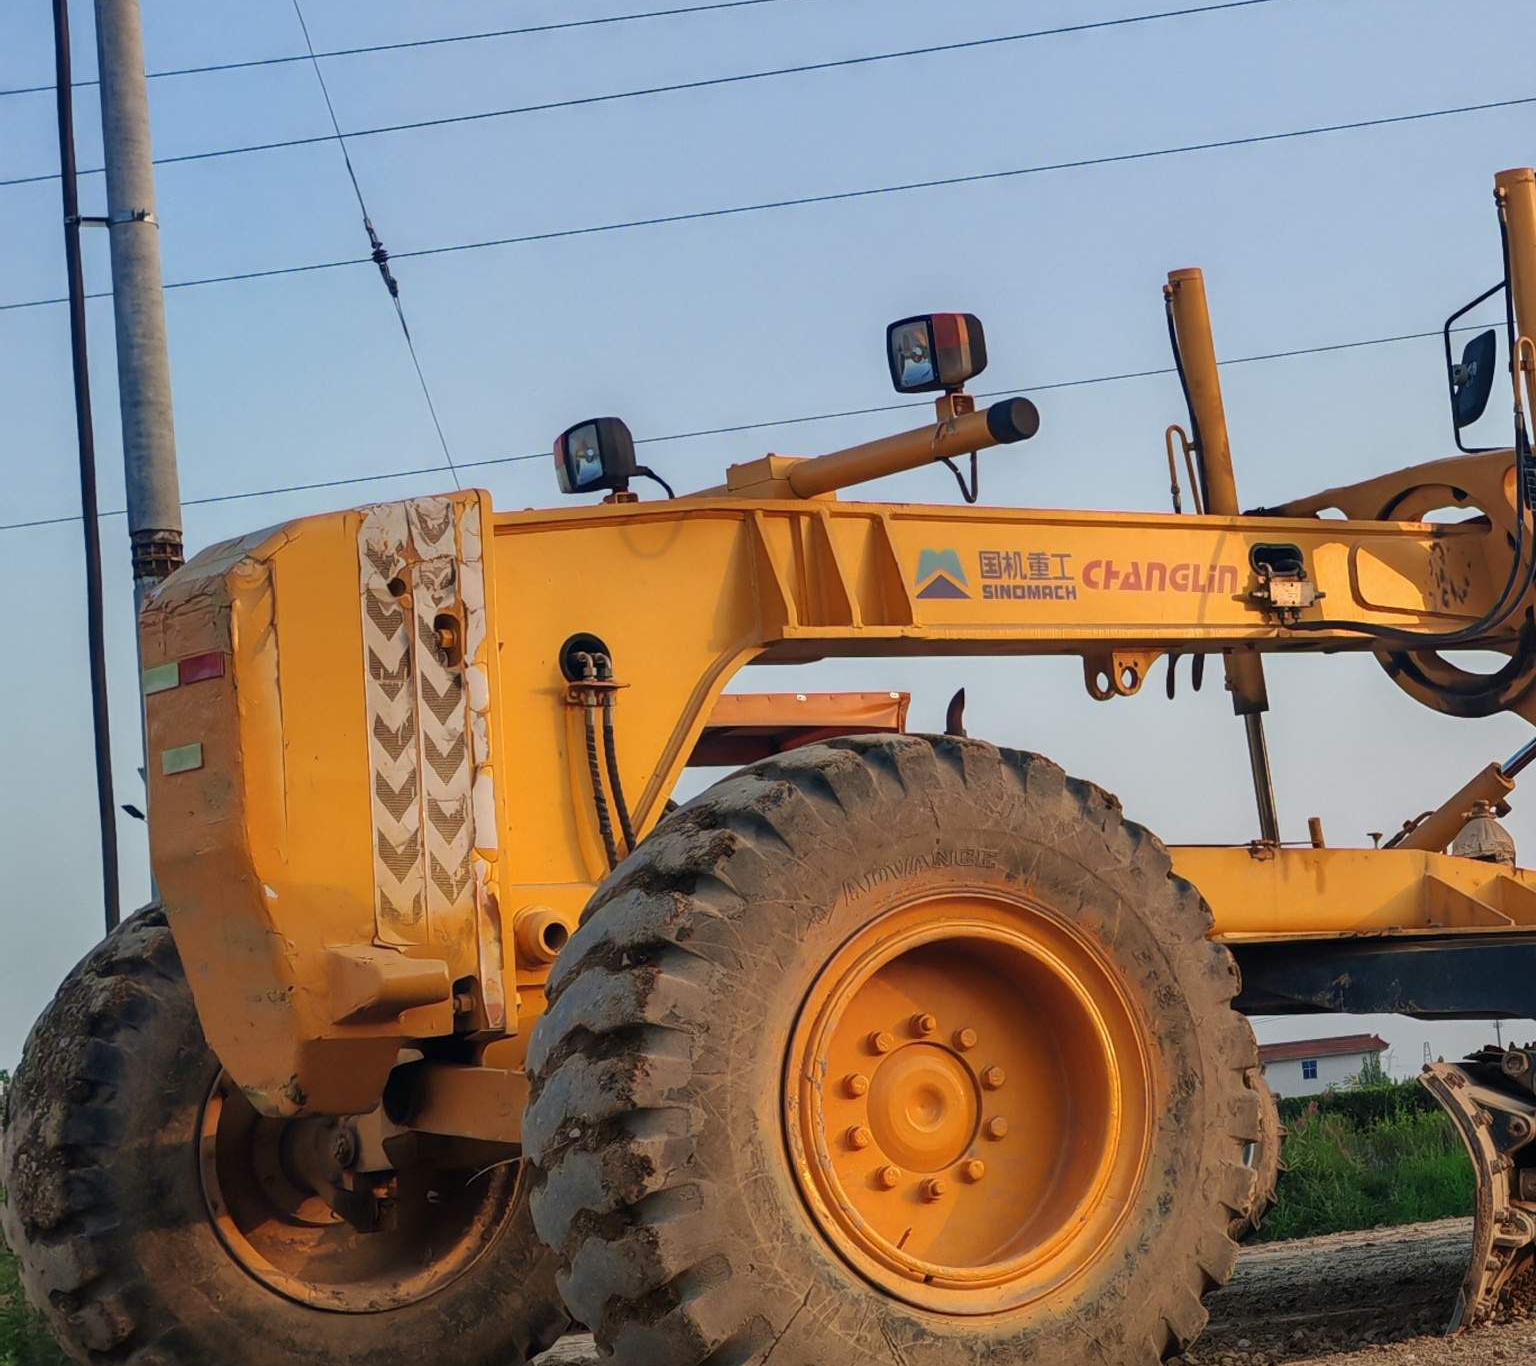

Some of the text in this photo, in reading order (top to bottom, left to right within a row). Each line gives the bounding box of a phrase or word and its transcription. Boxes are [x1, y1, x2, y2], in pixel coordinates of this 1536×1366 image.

[978, 550, 1075, 581] 国机重工
[982, 584, 1077, 601] SINOMACH
